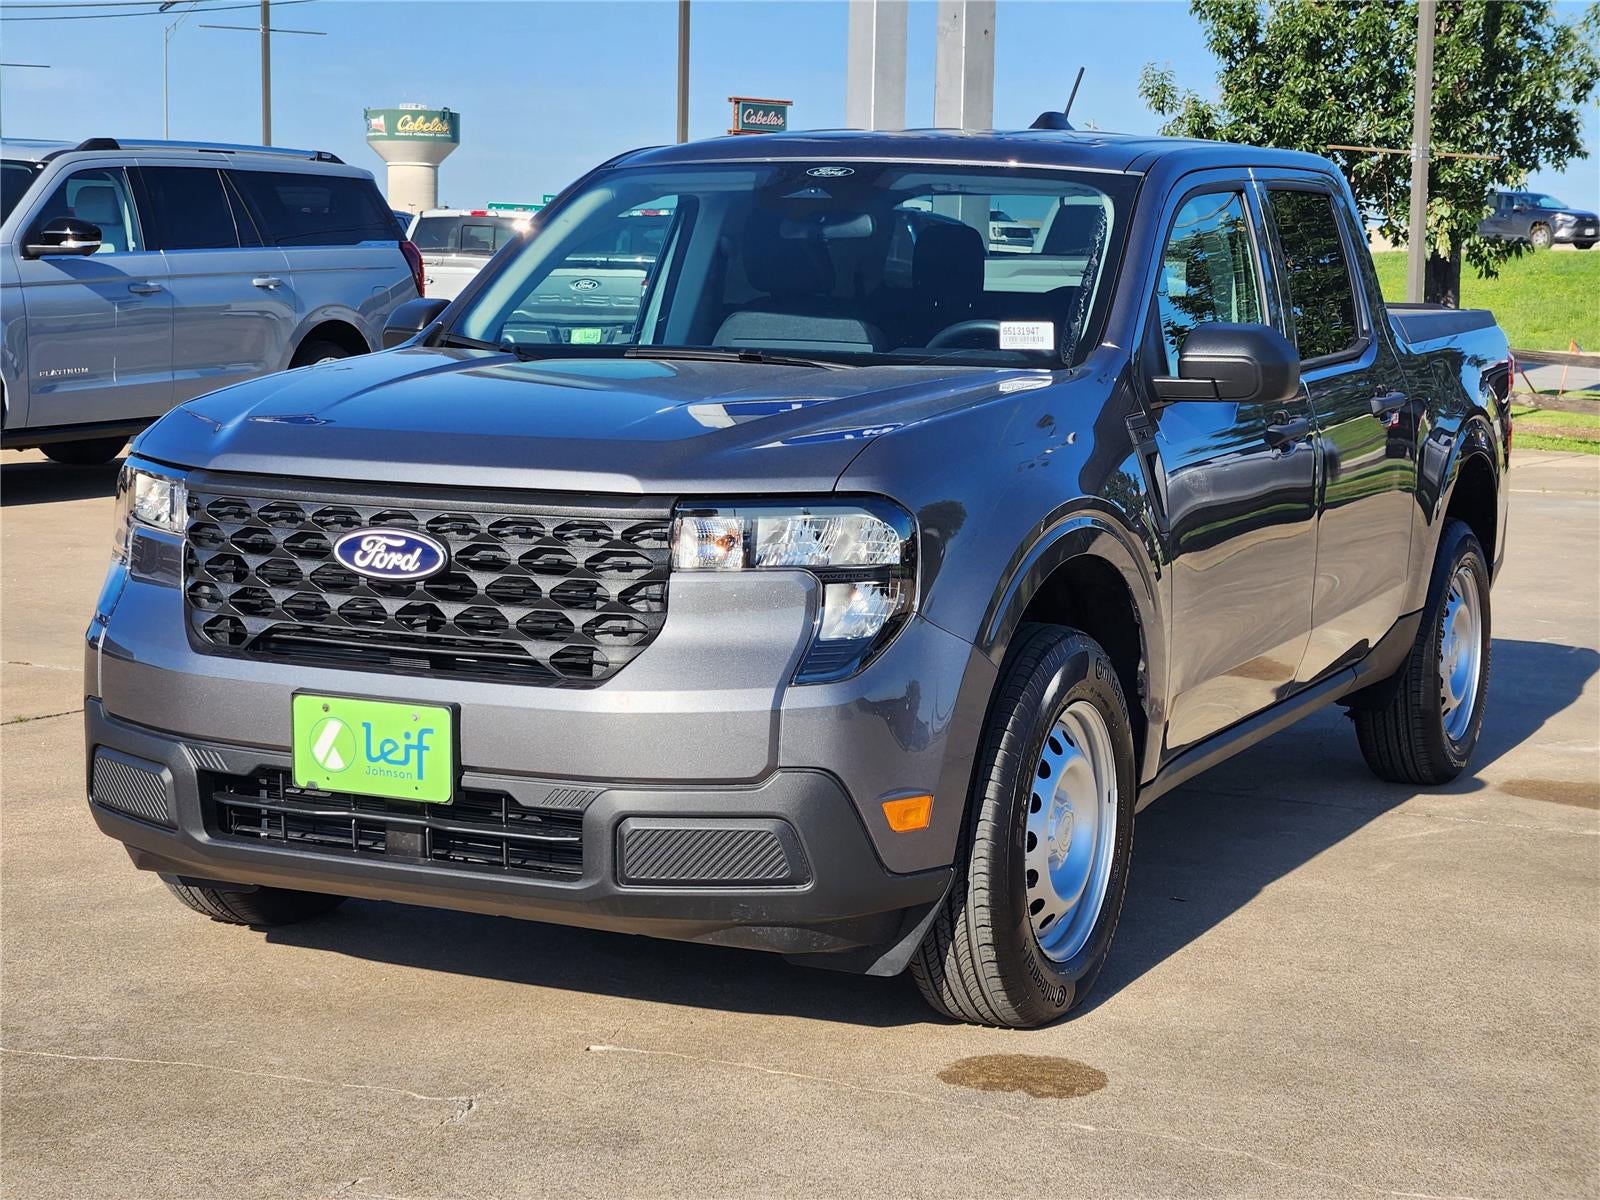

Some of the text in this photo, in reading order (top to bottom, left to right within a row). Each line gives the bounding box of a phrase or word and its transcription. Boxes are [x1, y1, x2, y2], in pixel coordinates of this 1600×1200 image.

[397, 114, 450, 134] Cabela's
[743, 109, 785, 126] Cabela's
[39, 367, 89, 377] PLATINUM
[354, 535, 423, 571] Ford
[365, 766, 413, 780] Johnson
[1023, 948, 1067, 1008] Continental
